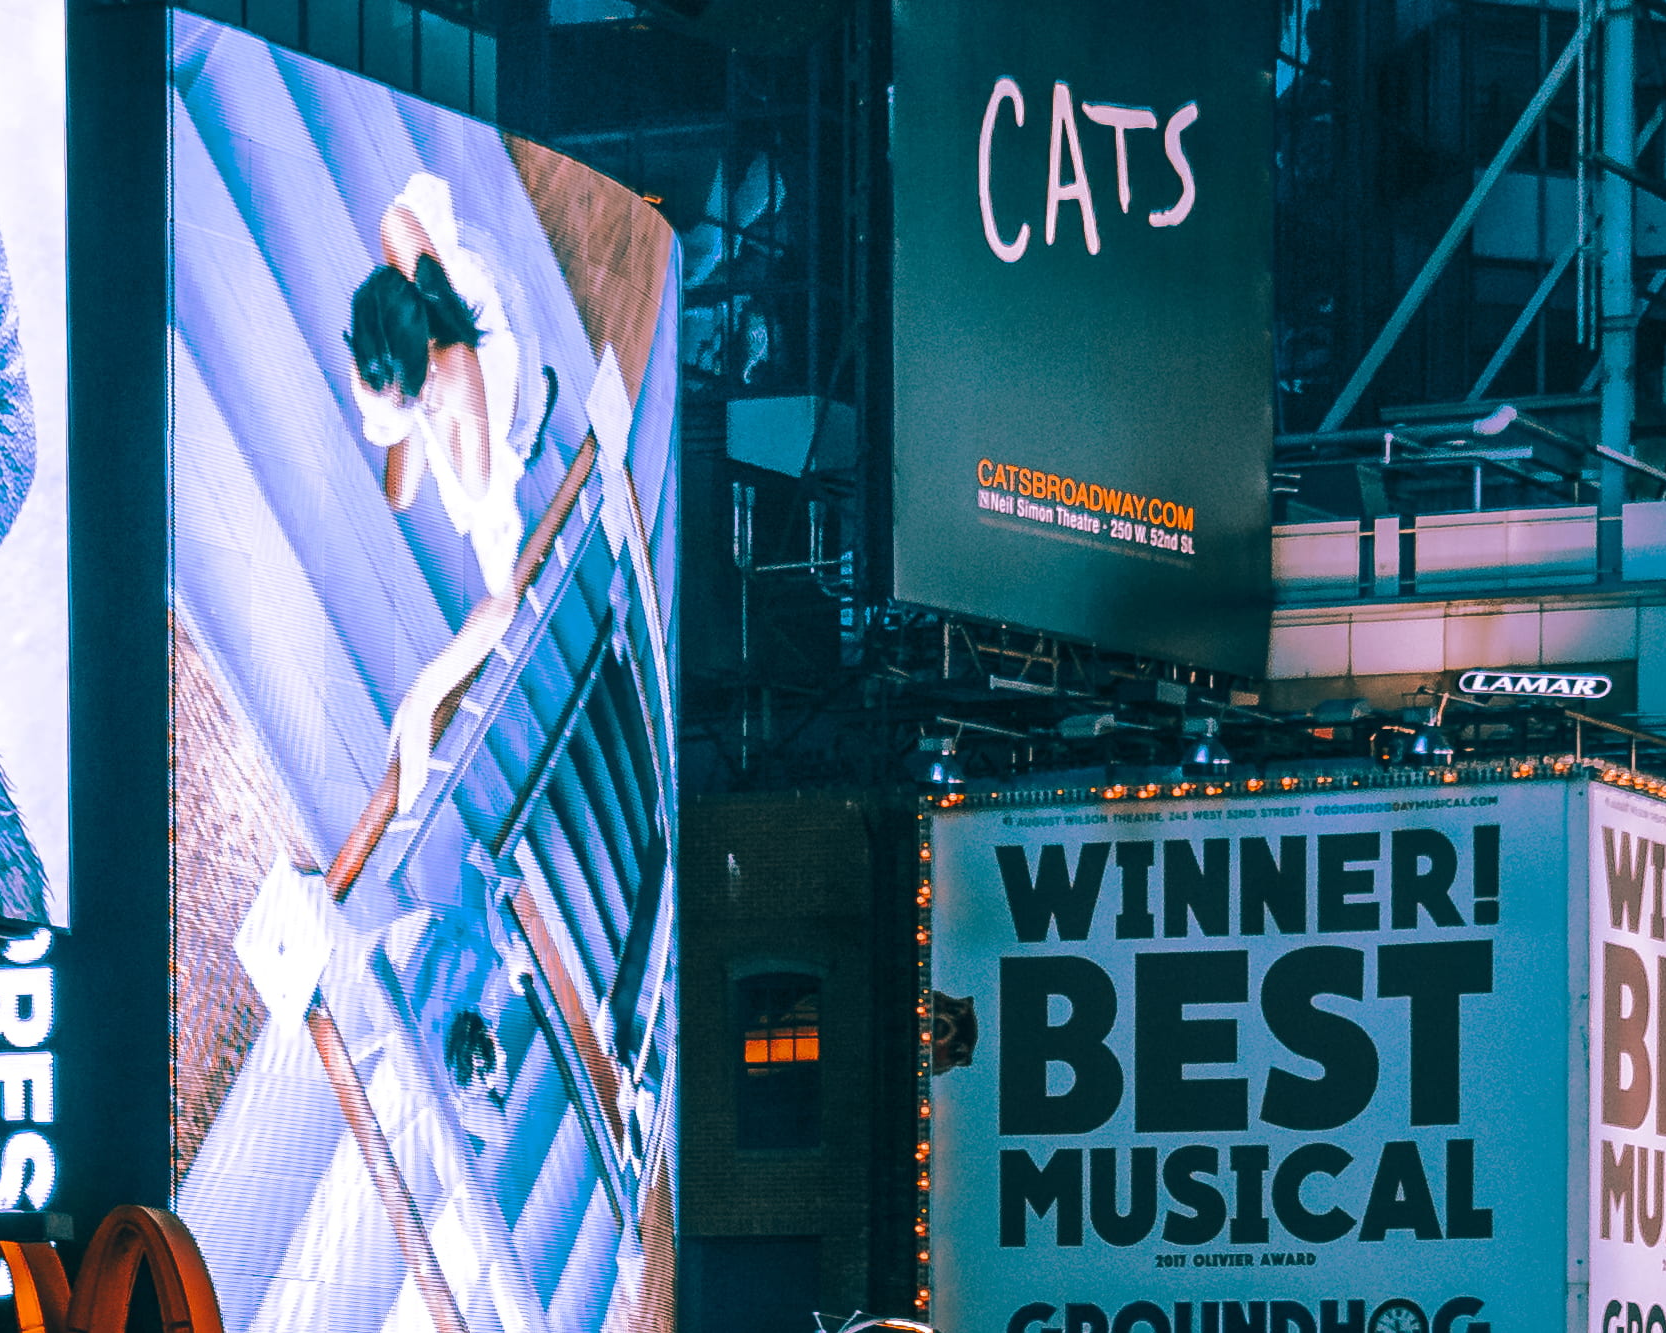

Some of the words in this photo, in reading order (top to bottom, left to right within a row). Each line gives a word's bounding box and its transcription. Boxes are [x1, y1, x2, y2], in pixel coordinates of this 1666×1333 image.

[978, 74, 1200, 263] CATS
[977, 458, 1194, 532] CATSBROADWAY.COM
[990, 493, 1014, 514] Neil
[1017, 498, 1054, 523] Simon
[1056, 506, 1101, 534] Theatre
[1110, 519, 1133, 541] 250
[1134, 525, 1148, 544] W.
[1150, 528, 1178, 551] 52nd
[1468, 674, 1599, 697] LAMAR
[1063, 813, 1108, 827] WILSON
[995, 825, 1500, 944] WINNER!
[998, 940, 1494, 1136] BEST
[998, 1138, 1493, 1248] MUSICAL
[1154, 1253, 1186, 1268] 2017
[1193, 1252, 1254, 1267] OLIVIER
[1260, 1250, 1317, 1267] AWARD
